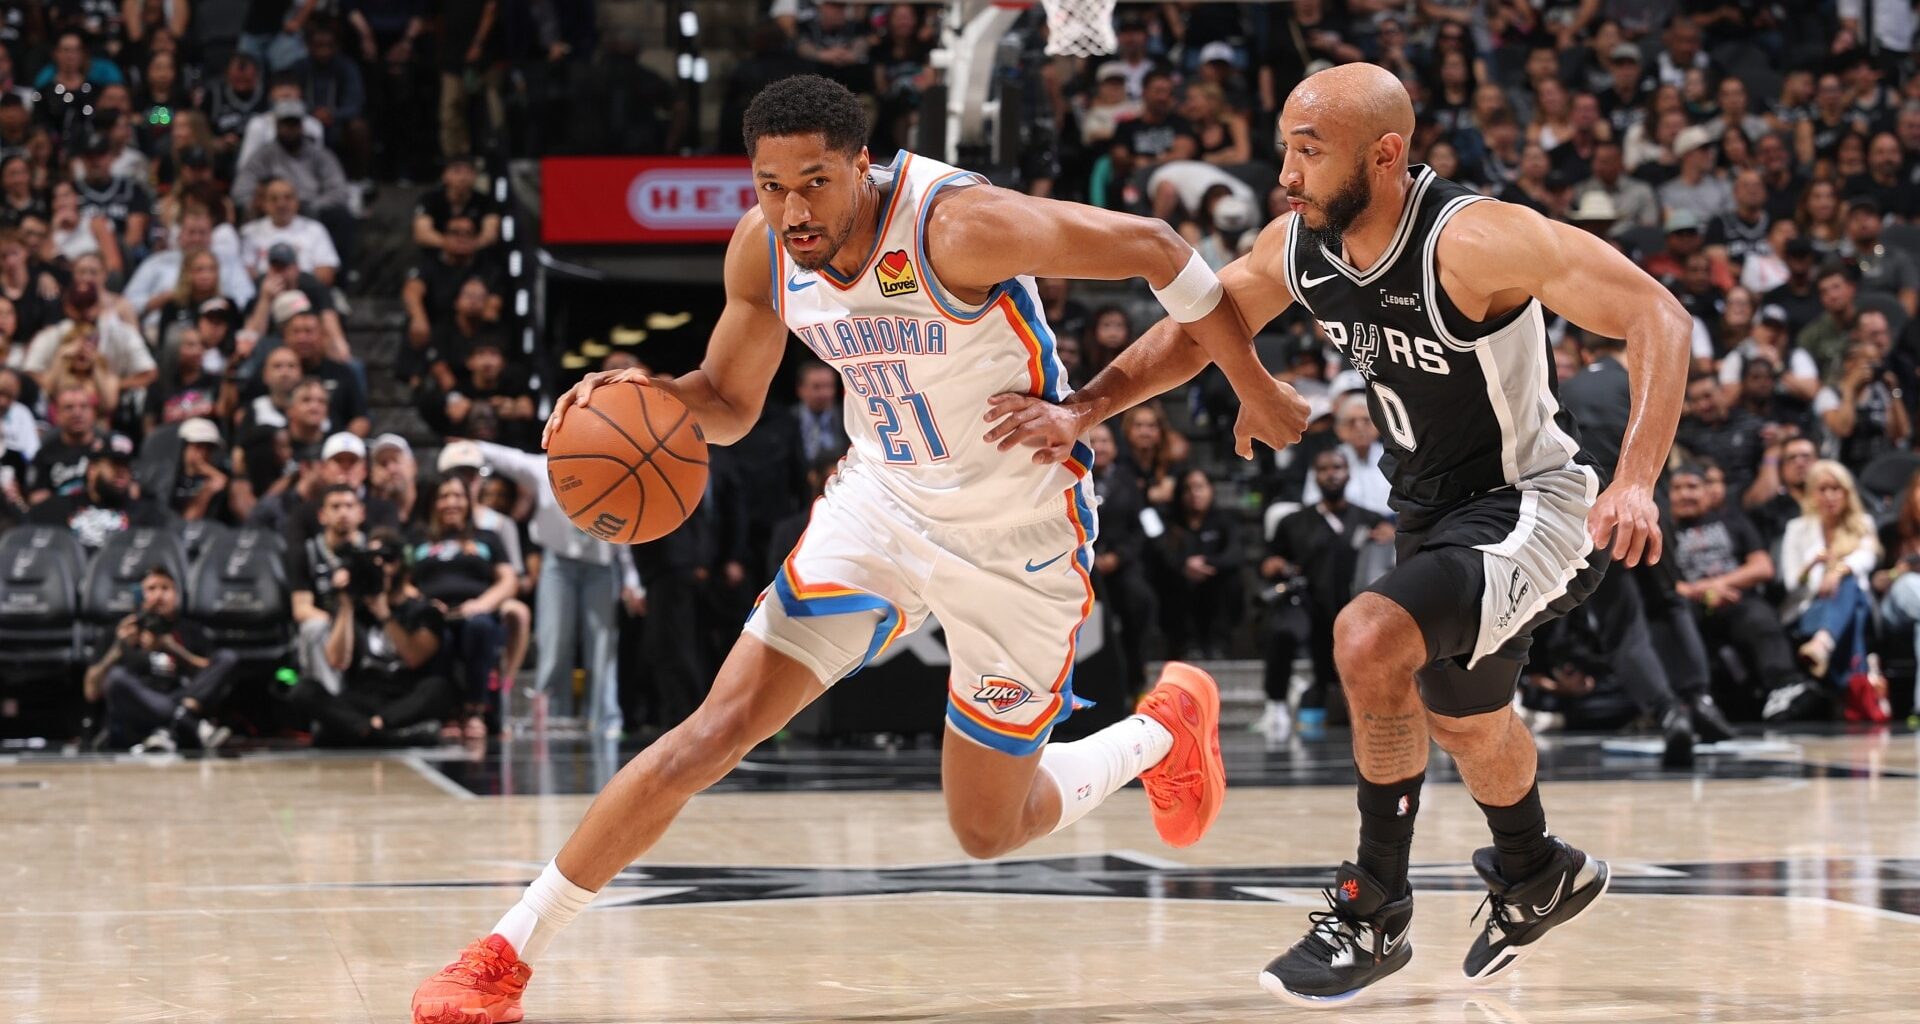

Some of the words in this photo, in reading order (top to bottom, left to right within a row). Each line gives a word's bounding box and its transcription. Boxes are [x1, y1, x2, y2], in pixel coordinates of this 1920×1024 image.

[1385, 294, 1416, 306] LEDGER
[798, 316, 946, 361] KLAHOMA
[841, 360, 914, 397] CITY
[868, 392, 950, 465] 21
[1372, 381, 1417, 453] 0
[973, 685, 1021, 700] OKC
